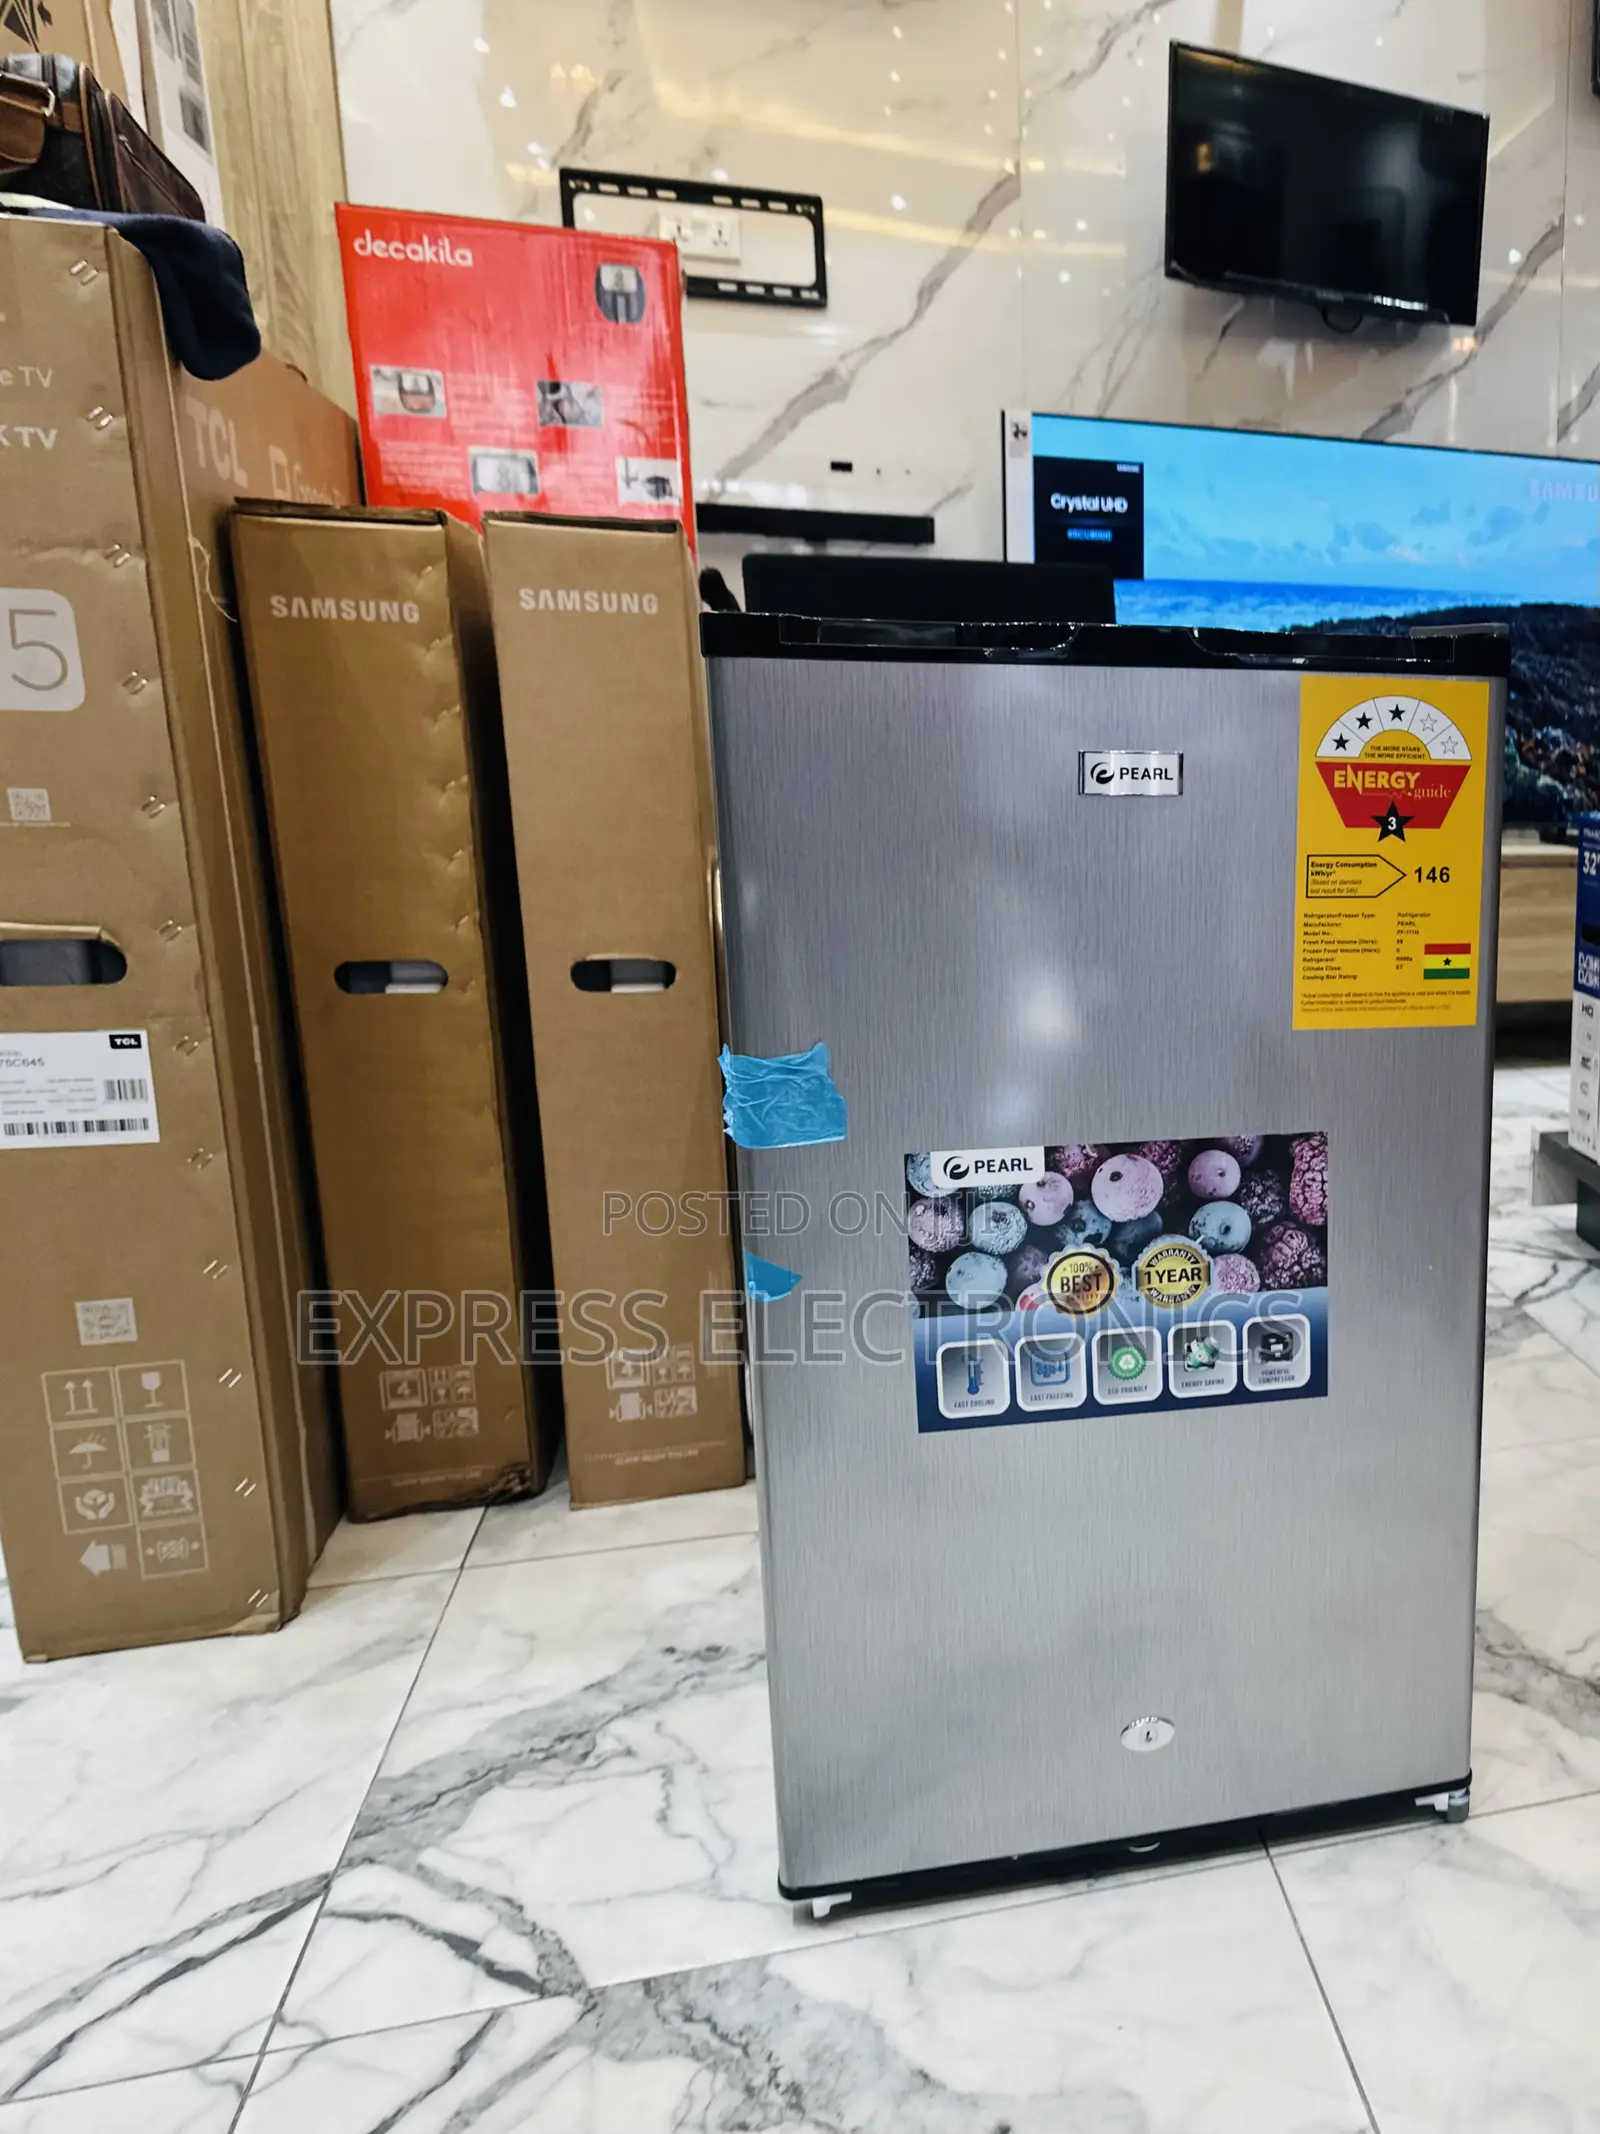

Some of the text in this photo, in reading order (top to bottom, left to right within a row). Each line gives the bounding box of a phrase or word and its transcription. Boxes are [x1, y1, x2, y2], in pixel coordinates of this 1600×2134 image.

[353, 230, 473, 267] decakila
[18, 365, 53, 388] TV
[13, 426, 58, 449] TV
[186, 394, 248, 488] TCL
[1050, 492, 1128, 514] Crystal UHD
[270, 594, 420, 624] SAMSUNG
[519, 587, 659, 615] SAMSUNG
[1119, 767, 1174, 781] PEARL
[1333, 763, 1421, 795] ENERGY
[1413, 783, 1451, 801] guide
[1387, 816, 1397, 831] 3
[1311, 861, 1377, 869] Energy Consumption
[1414, 866, 1450, 883] 146
[114, 1037, 138, 1046] TCL
[974, 1157, 1033, 1174] PEARL
[1149, 1248, 1198, 1266] WARRANTY
[1069, 1261, 1093, 1274] 100%
[1144, 1267, 1202, 1285] 1 YEAR
[1060, 1272, 1101, 1294] BEST
[1149, 1284, 1198, 1303] WARRANTY
[1045, 1392, 1074, 1401] FREEZING
[1120, 1385, 1148, 1394] FRIENDLY
[970, 1399, 995, 1408] COOLING
